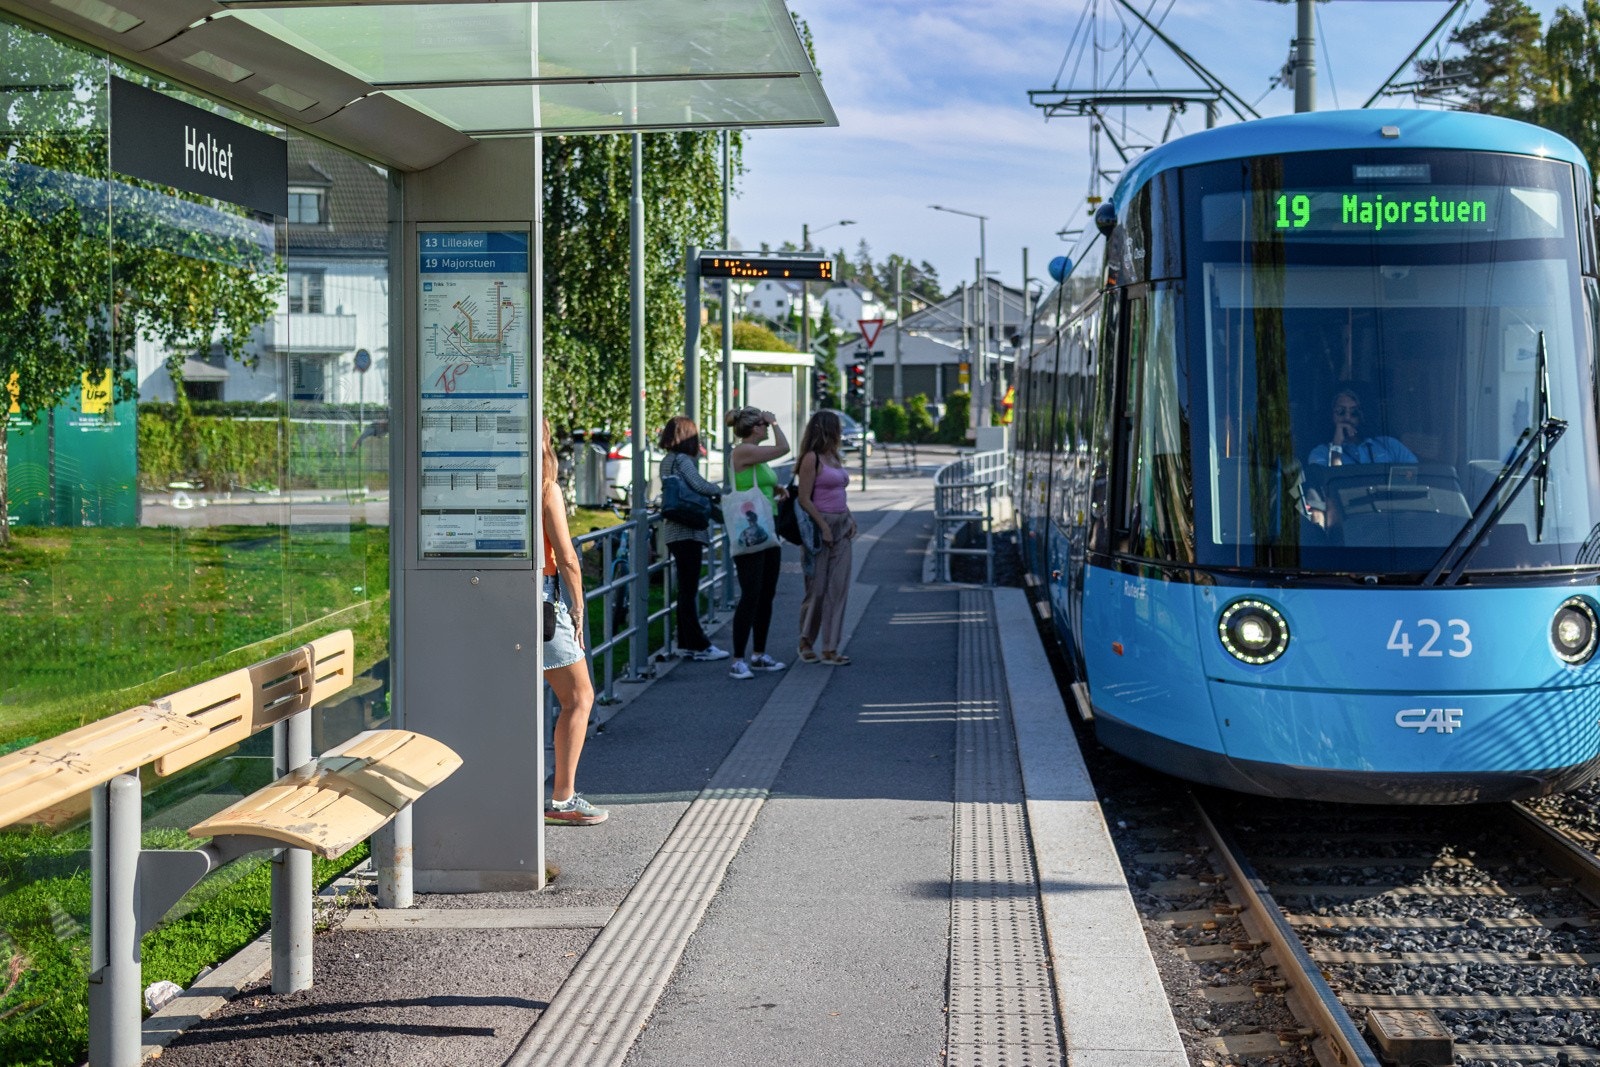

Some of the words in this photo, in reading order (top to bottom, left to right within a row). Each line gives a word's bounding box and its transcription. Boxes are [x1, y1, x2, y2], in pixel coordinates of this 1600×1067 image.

[185, 125, 233, 181] Holtet
[1276, 194, 1310, 228] 19
[1342, 194, 1486, 231] Majorstuen
[425, 238, 438, 248] 13
[442, 238, 484, 248] Lilleaker
[425, 259, 438, 268] 19
[442, 259, 496, 270] Majorstuen
[1386, 618, 1473, 658] 423
[1395, 708, 1463, 734] CAF
